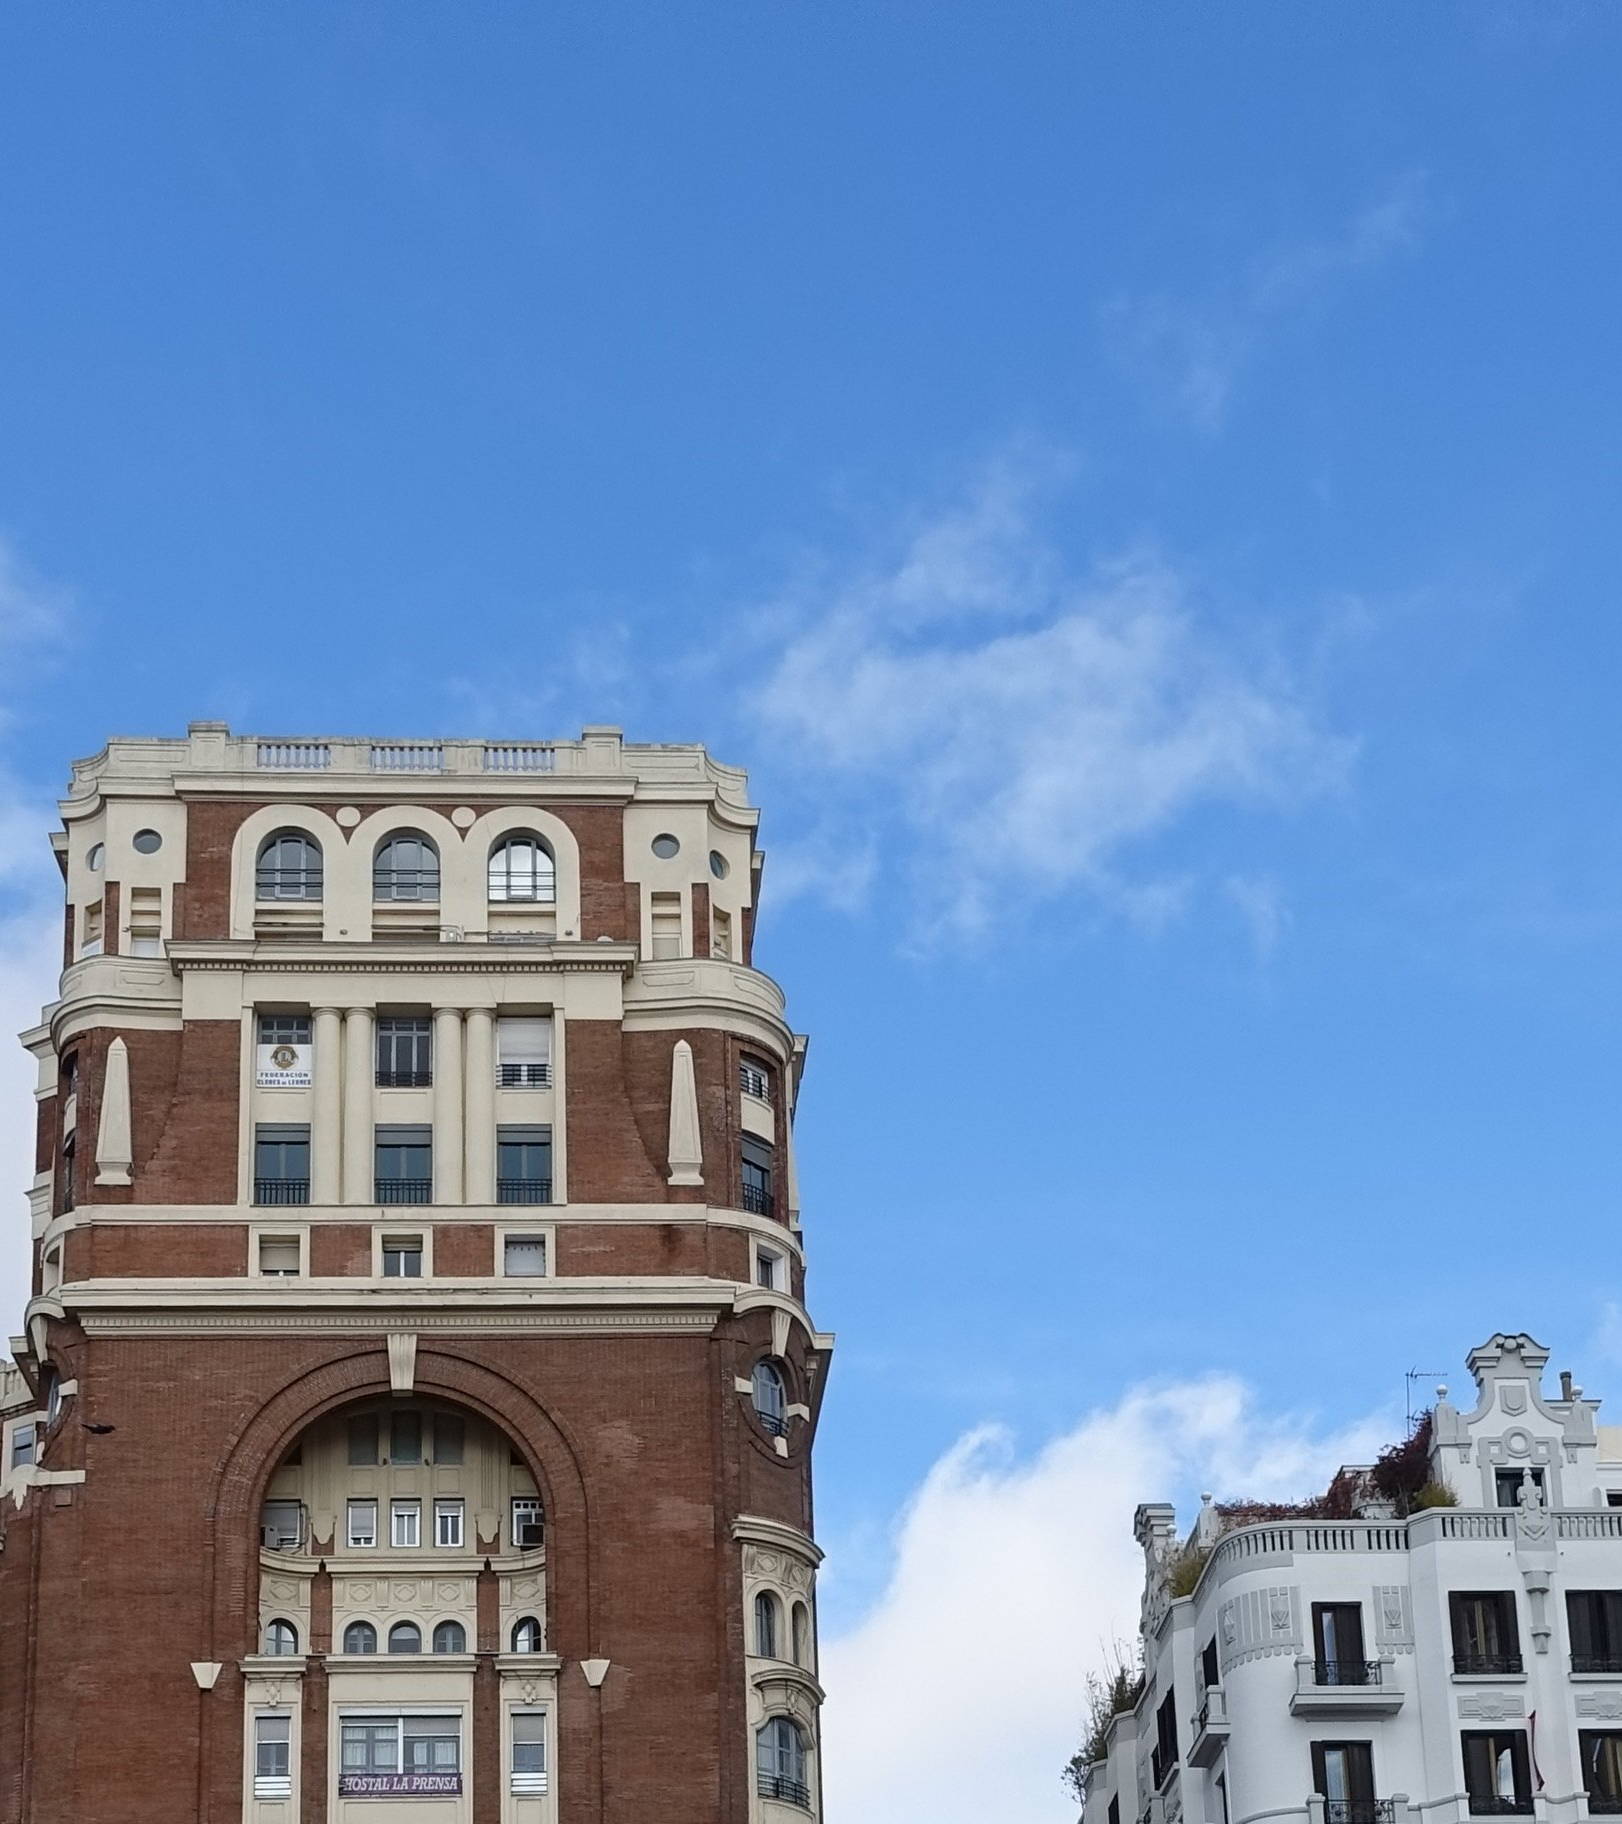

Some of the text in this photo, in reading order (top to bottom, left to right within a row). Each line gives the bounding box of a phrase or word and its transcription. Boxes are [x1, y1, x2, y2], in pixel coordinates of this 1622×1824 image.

[343, 1776, 458, 1791] HOSTAL LA PRENSA
